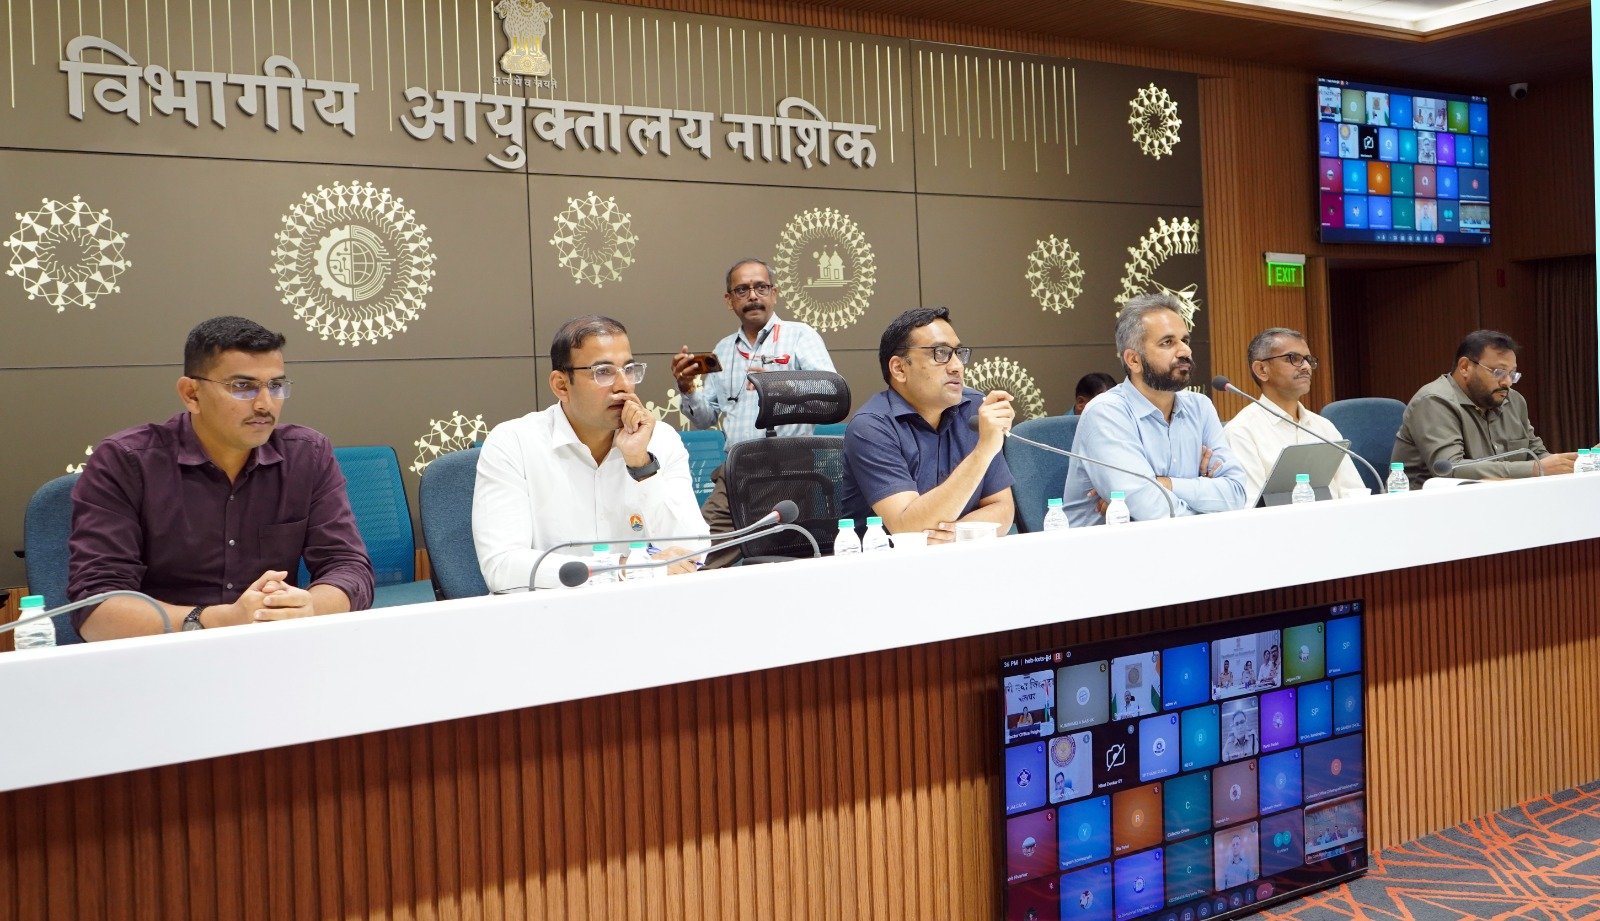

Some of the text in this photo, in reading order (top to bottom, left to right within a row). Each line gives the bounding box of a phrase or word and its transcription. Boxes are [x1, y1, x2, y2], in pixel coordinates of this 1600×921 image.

[59, 35, 878, 169] विभागीय आयुक्तालय नाशिक
[1275, 267, 1296, 283] EXIT
[1010, 659, 1019, 667] PM
